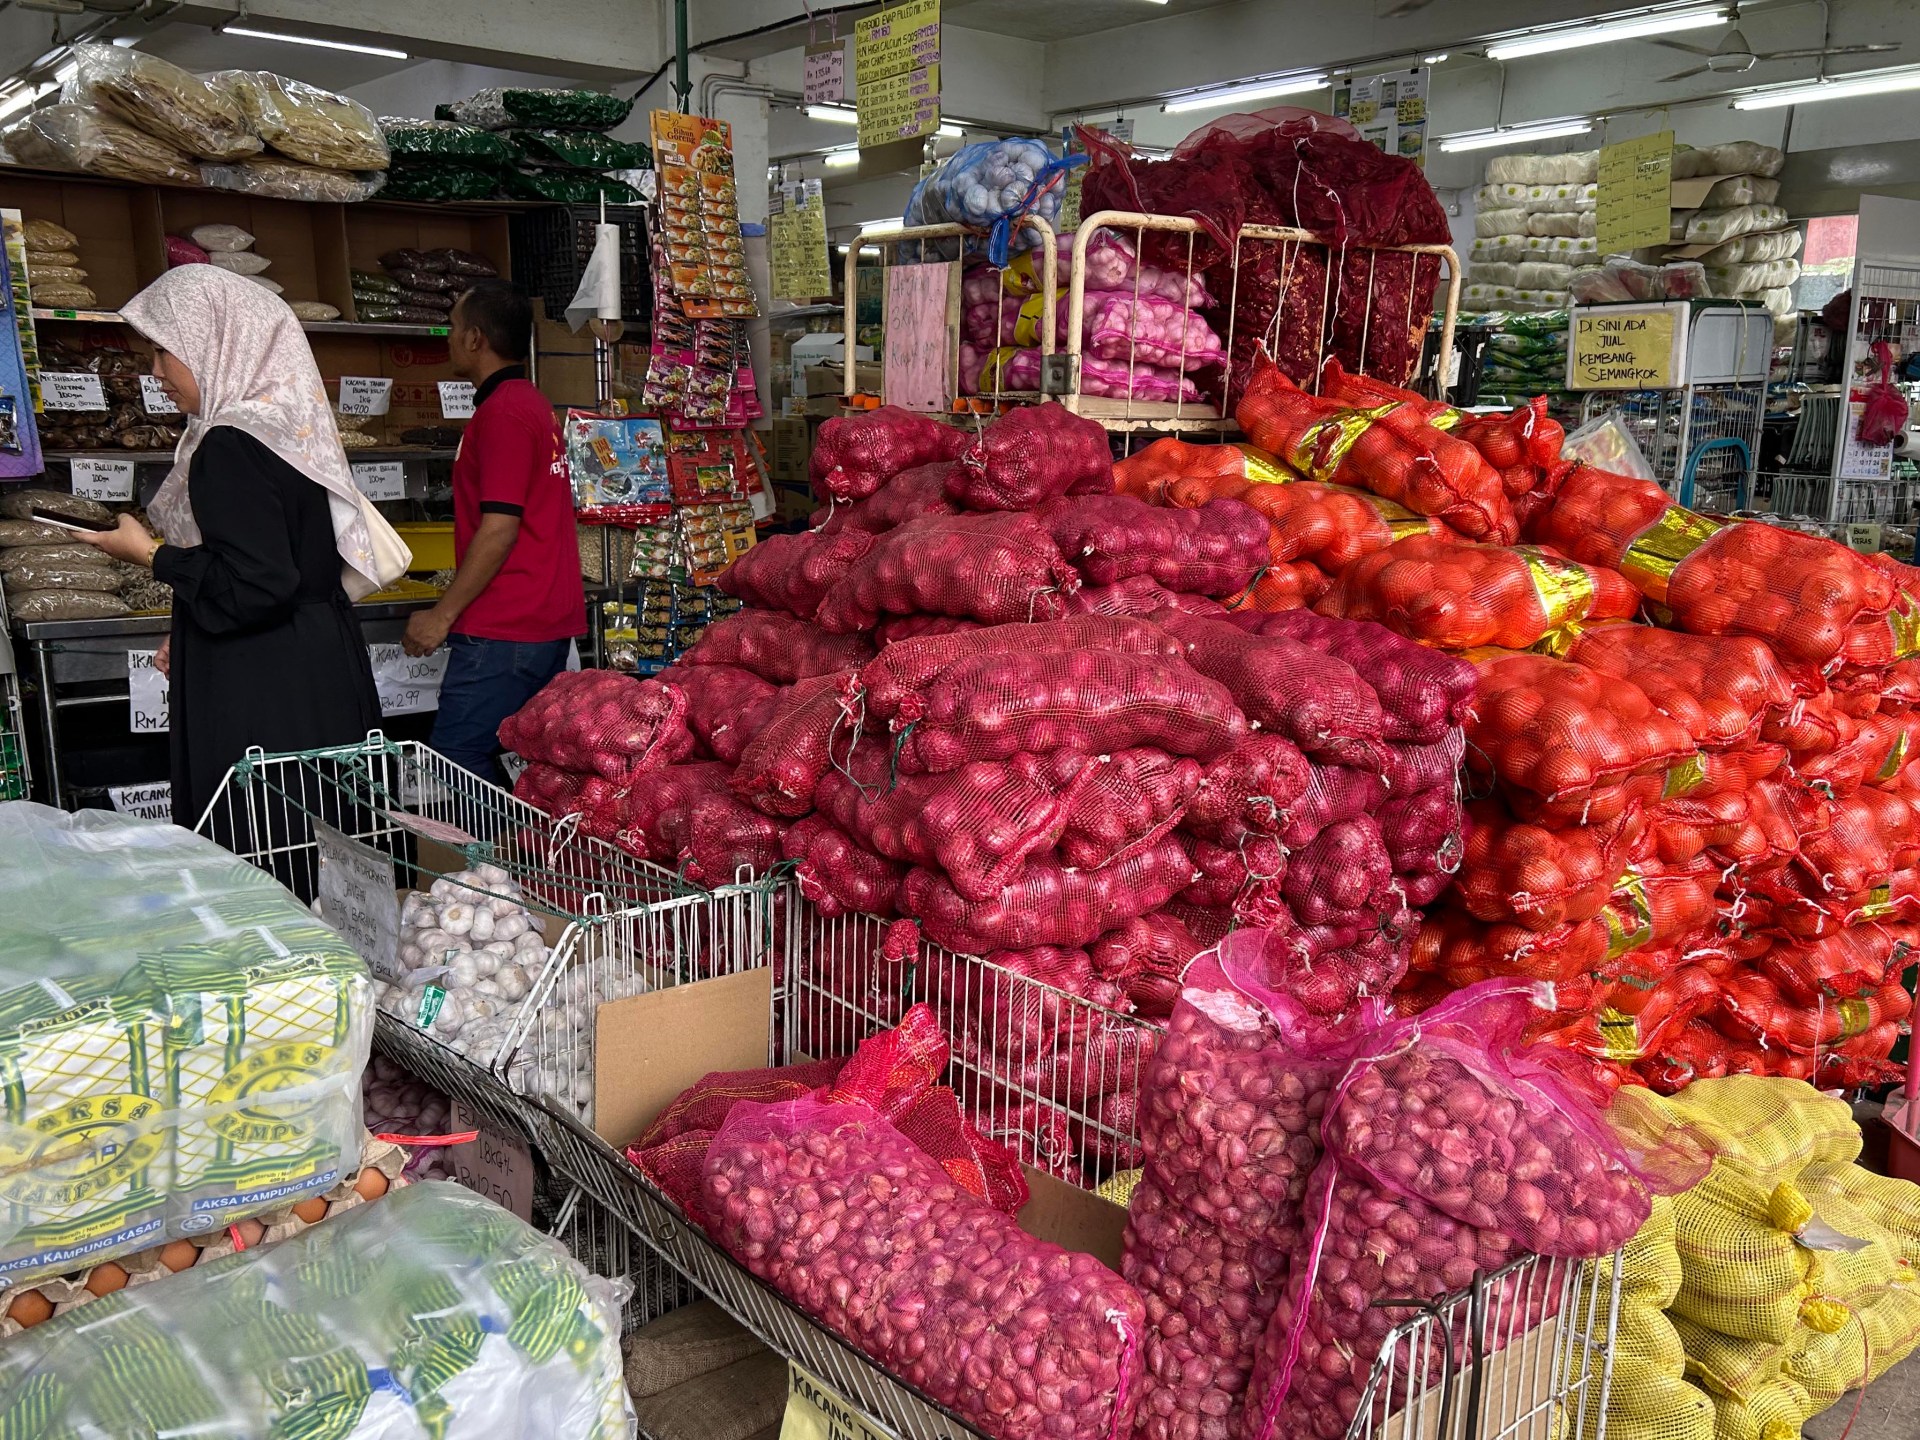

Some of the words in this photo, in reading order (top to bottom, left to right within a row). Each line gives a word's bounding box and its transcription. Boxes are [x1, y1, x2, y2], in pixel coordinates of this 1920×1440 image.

[667, 132, 696, 144] Goreng
[1624, 320, 1646, 331] ADA
[1596, 335, 1625, 348] JUAL
[1579, 352, 1636, 366] KEMBANG
[1584, 367, 1659, 382] SEMANGKOK
[94, 463, 112, 472] BULU
[1852, 537, 1872, 545] KERAS
[132, 654, 154, 668] IKA
[376, 648, 399, 663] IKAN
[352, 907, 377, 932] BARANG
[194, 1197, 238, 1210] LAKSA
[241, 1183, 303, 1203] KAMPUNG
[306, 1171, 337, 1187] KASA
[0, 1258, 38, 1272] AKSA
[43, 1238, 112, 1263] KAMPUNG
[117, 1220, 161, 1242] KASAR
[792, 1366, 853, 1432] KACANG
